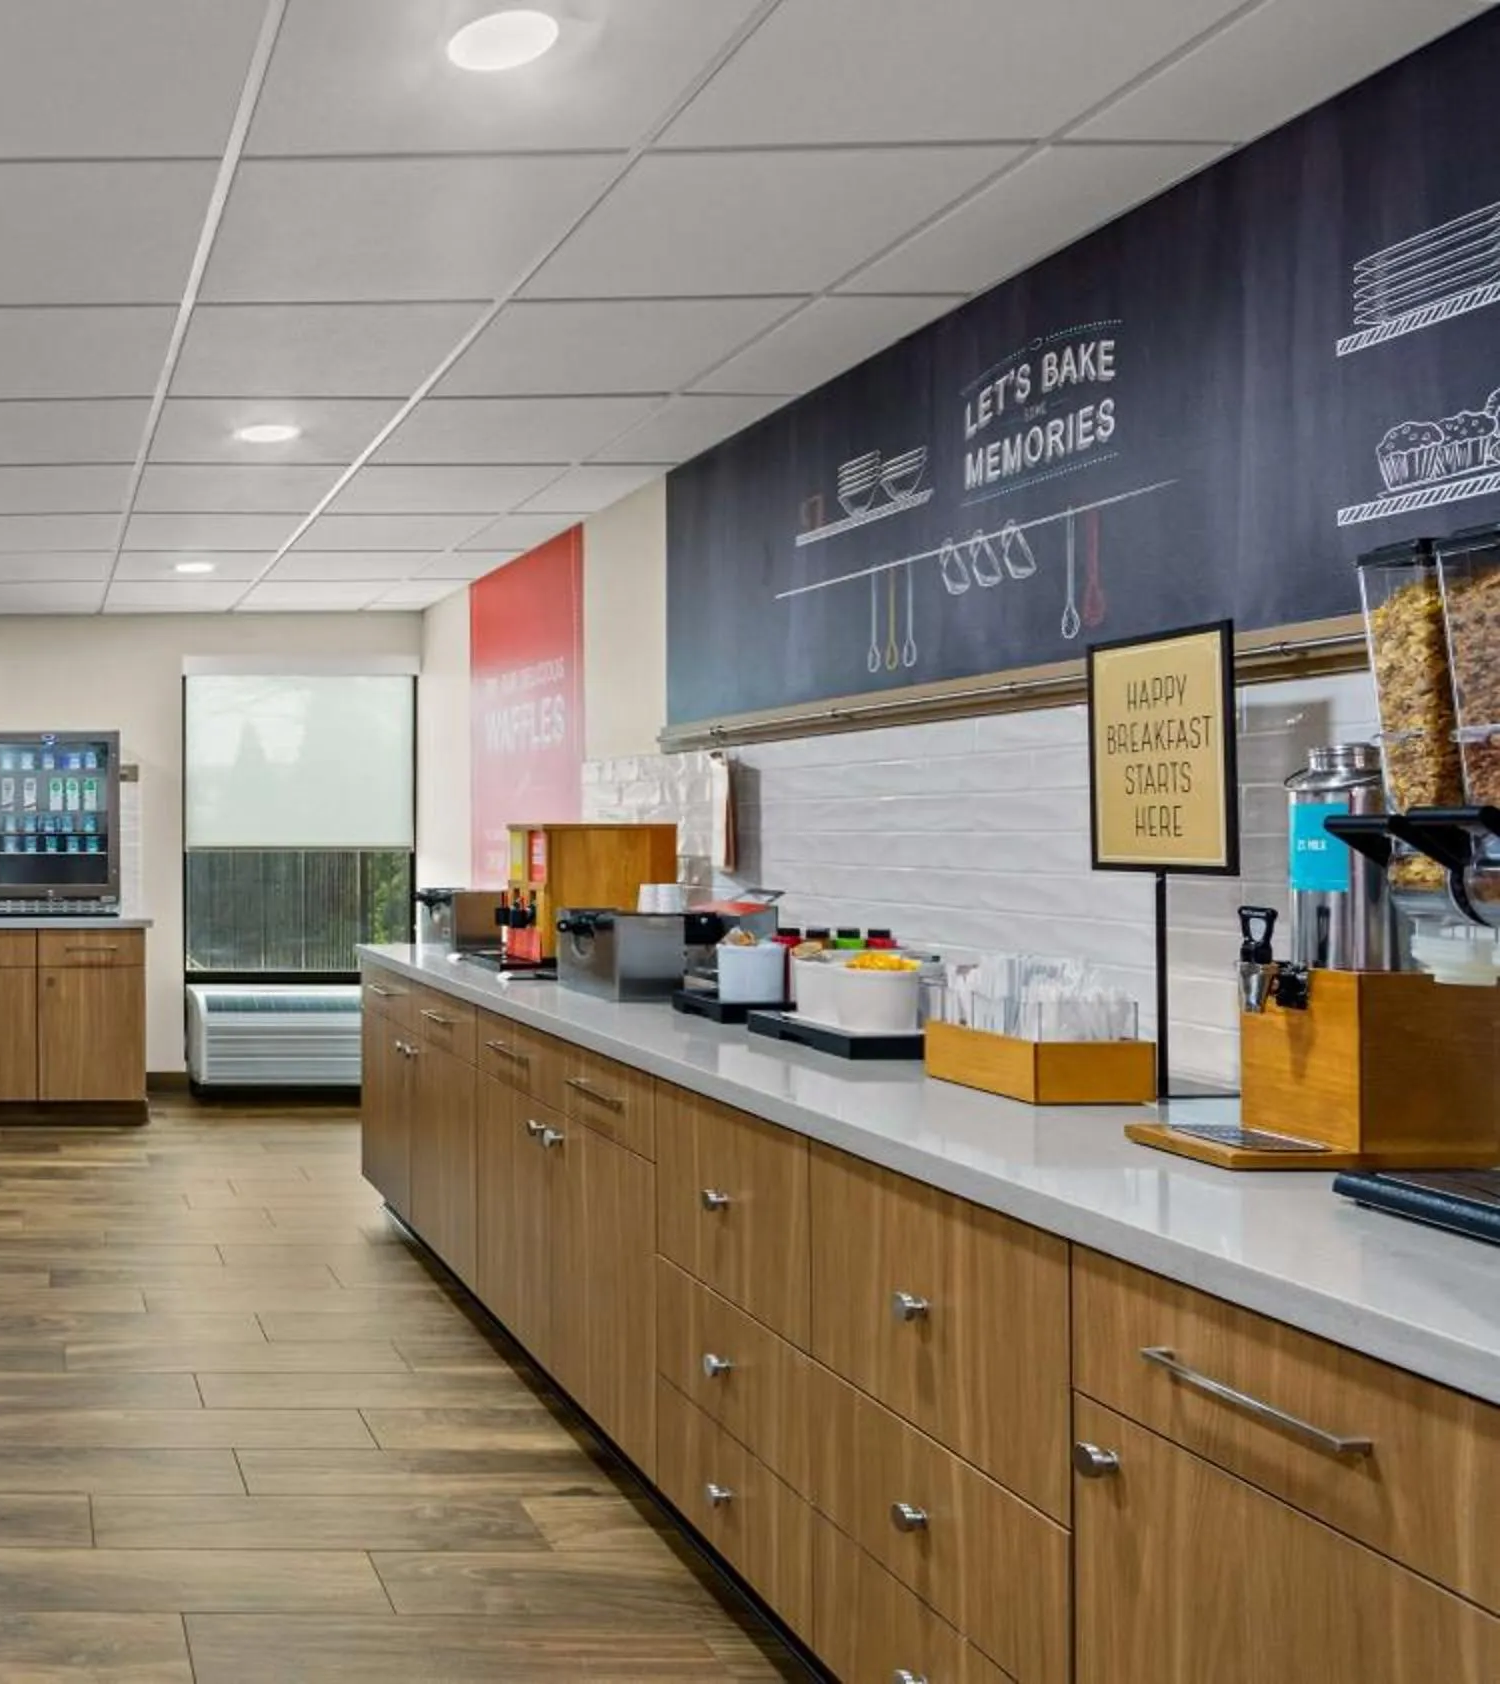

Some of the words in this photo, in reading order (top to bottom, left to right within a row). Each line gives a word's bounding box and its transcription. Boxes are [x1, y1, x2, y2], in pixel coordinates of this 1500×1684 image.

[965, 363, 1032, 440] LET'S
[1041, 339, 1116, 394] BAKE
[965, 398, 1116, 491] MEMORIES
[1125, 673, 1188, 713] HAPPY
[484, 693, 566, 756] WAFFLES
[1106, 714, 1214, 755] BREAKFAST
[1124, 761, 1193, 796] STARTS
[1134, 804, 1185, 838] HERE
